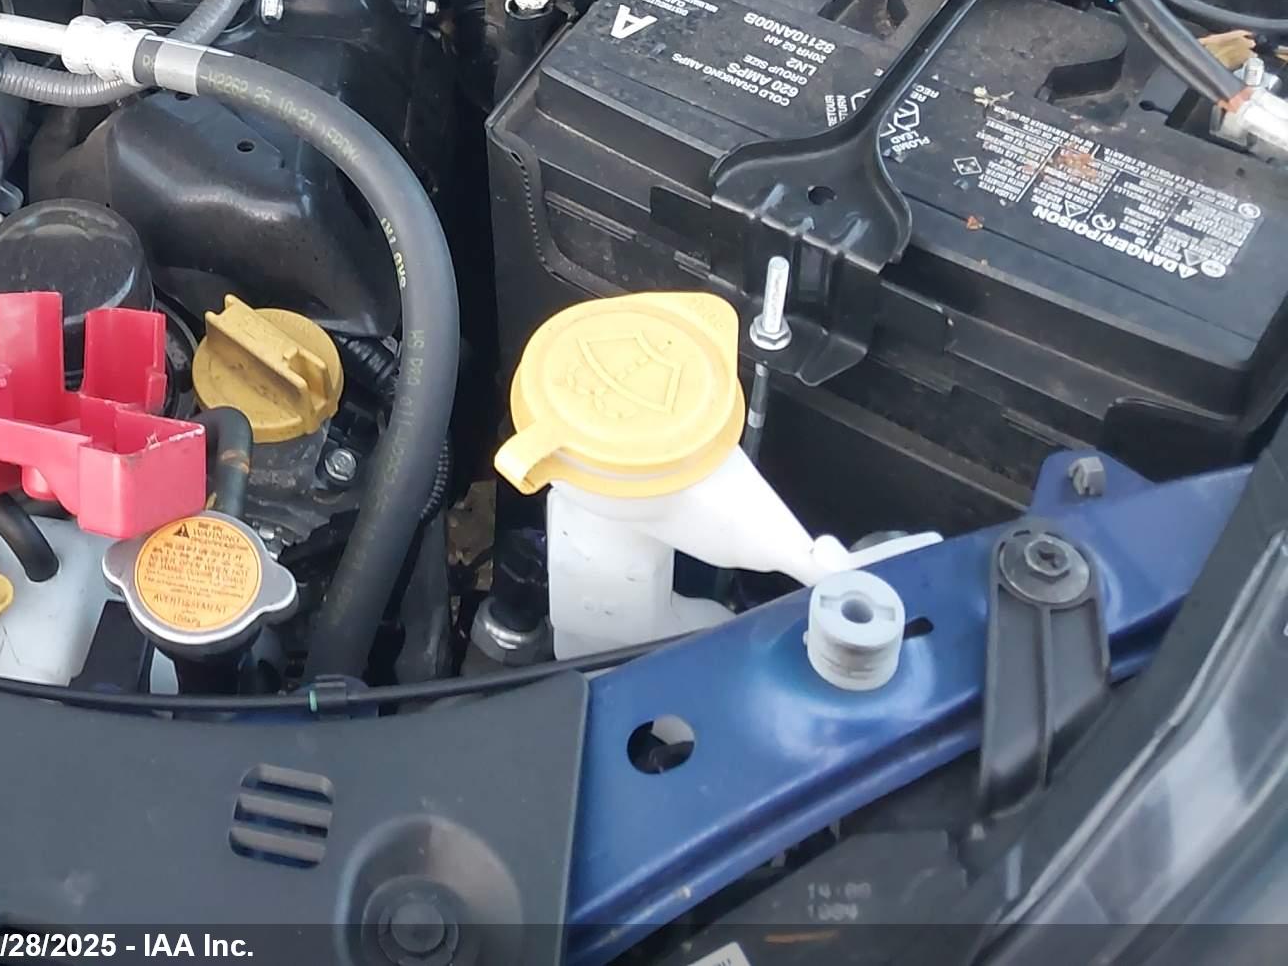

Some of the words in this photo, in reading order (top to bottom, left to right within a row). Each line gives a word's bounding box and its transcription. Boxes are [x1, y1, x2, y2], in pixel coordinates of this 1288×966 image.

[610, 4, 658, 39] A
[741, 11, 837, 53] 82110AN00B
[762, 33, 783, 46] AH
[780, 40, 798, 52] 62
[794, 46, 827, 63] 20HR
[670, 52, 704, 70] AMPS
[741, 53, 769, 69] SIZE
[784, 56, 818, 75] LN2
[701, 64, 760, 93] CRANKING
[724, 61, 773, 86] AMPS
[766, 63, 809, 85] GROUP
[756, 88, 791, 107] COLD
[769, 79, 800, 97] 620
[890, 130, 919, 144] LEAD
[1030, 204, 1180, 272] DANGER/POISON
